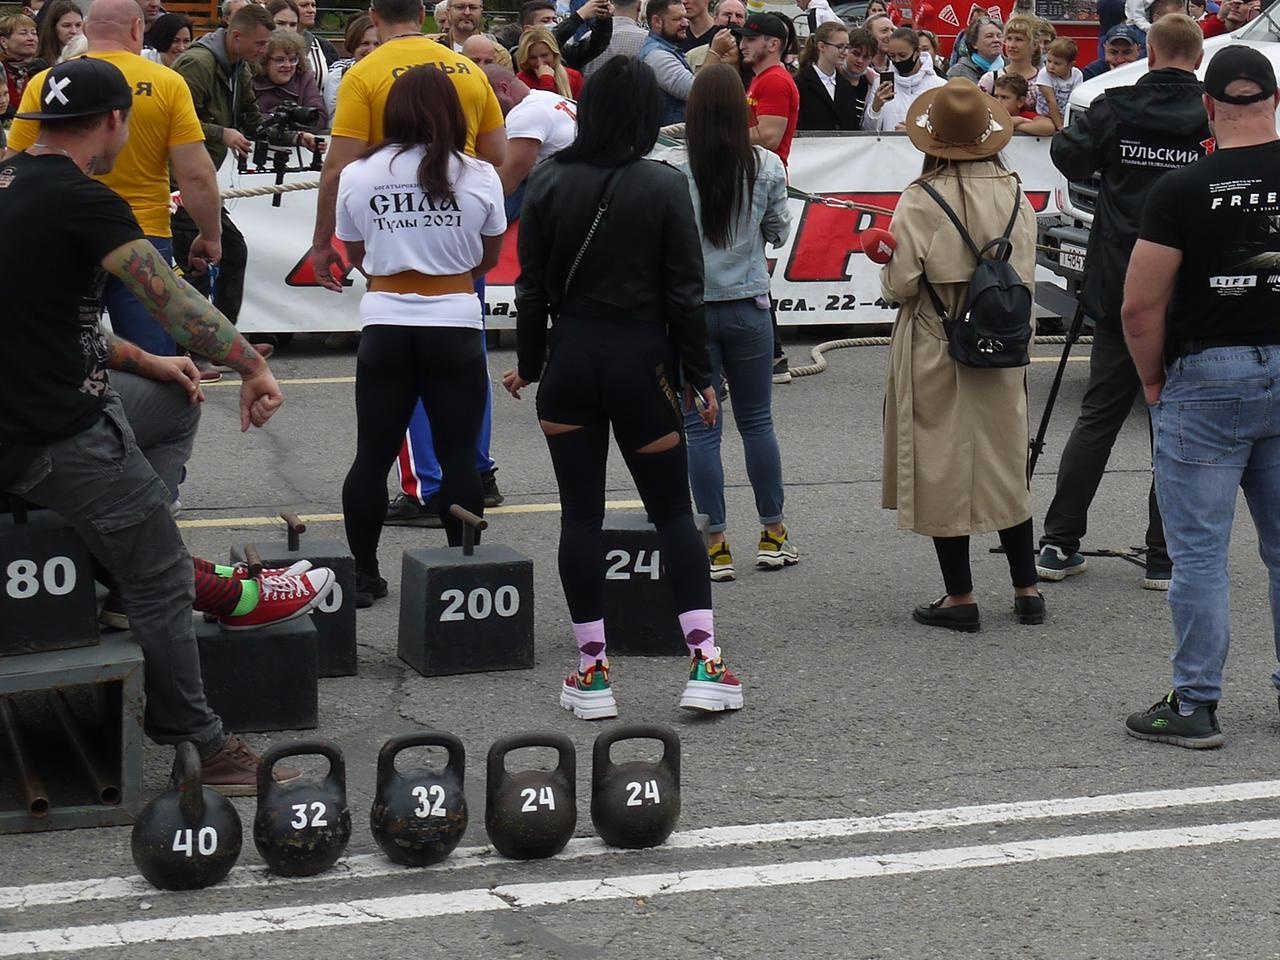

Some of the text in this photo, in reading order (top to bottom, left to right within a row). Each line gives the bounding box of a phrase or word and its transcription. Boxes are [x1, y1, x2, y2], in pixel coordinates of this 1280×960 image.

[1120, 144, 1199, 163] ТУЛЬСКИЙ
[374, 214, 462, 233] Тулы 2021
[1216, 277, 1251, 286] LIFE
[6, 556, 77, 599] 80
[440, 585, 520, 622] 200
[411, 785, 447, 818] 32
[520, 786, 556, 813] 24
[626, 780, 661, 807] 24
[291, 802, 328, 830] 32
[172, 826, 218, 857] 40
